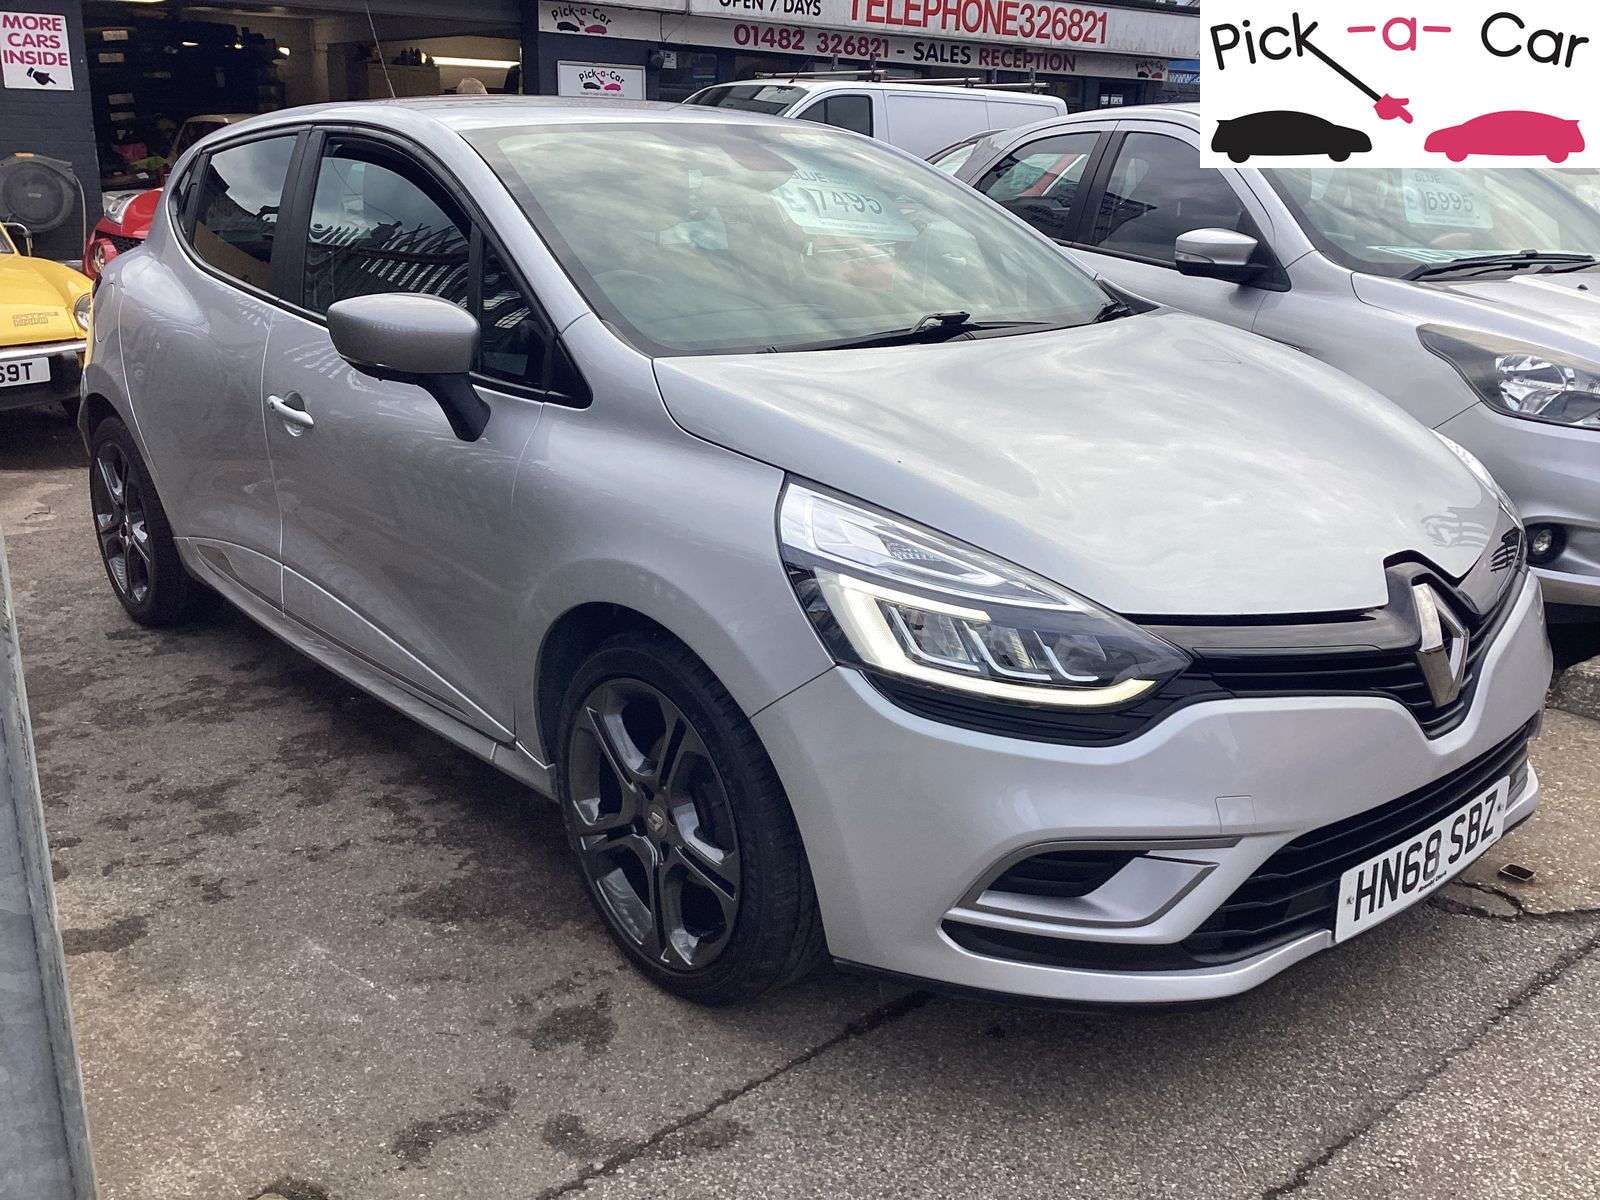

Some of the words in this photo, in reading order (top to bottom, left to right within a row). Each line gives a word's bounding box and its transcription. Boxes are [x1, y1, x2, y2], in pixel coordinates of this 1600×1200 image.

[784, 0, 822, 16] DAYS
[2, 14, 63, 32] MORE
[8, 32, 61, 49] CARS
[733, 23, 805, 51] 01482
[816, 32, 889, 58] 326821
[912, 41, 971, 65] SALES
[978, 48, 1076, 73] RECEPTION
[3, 49, 69, 66] INSIDE
[1353, 829, 1443, 922] HN68
[1447, 789, 1499, 865] SBZ
